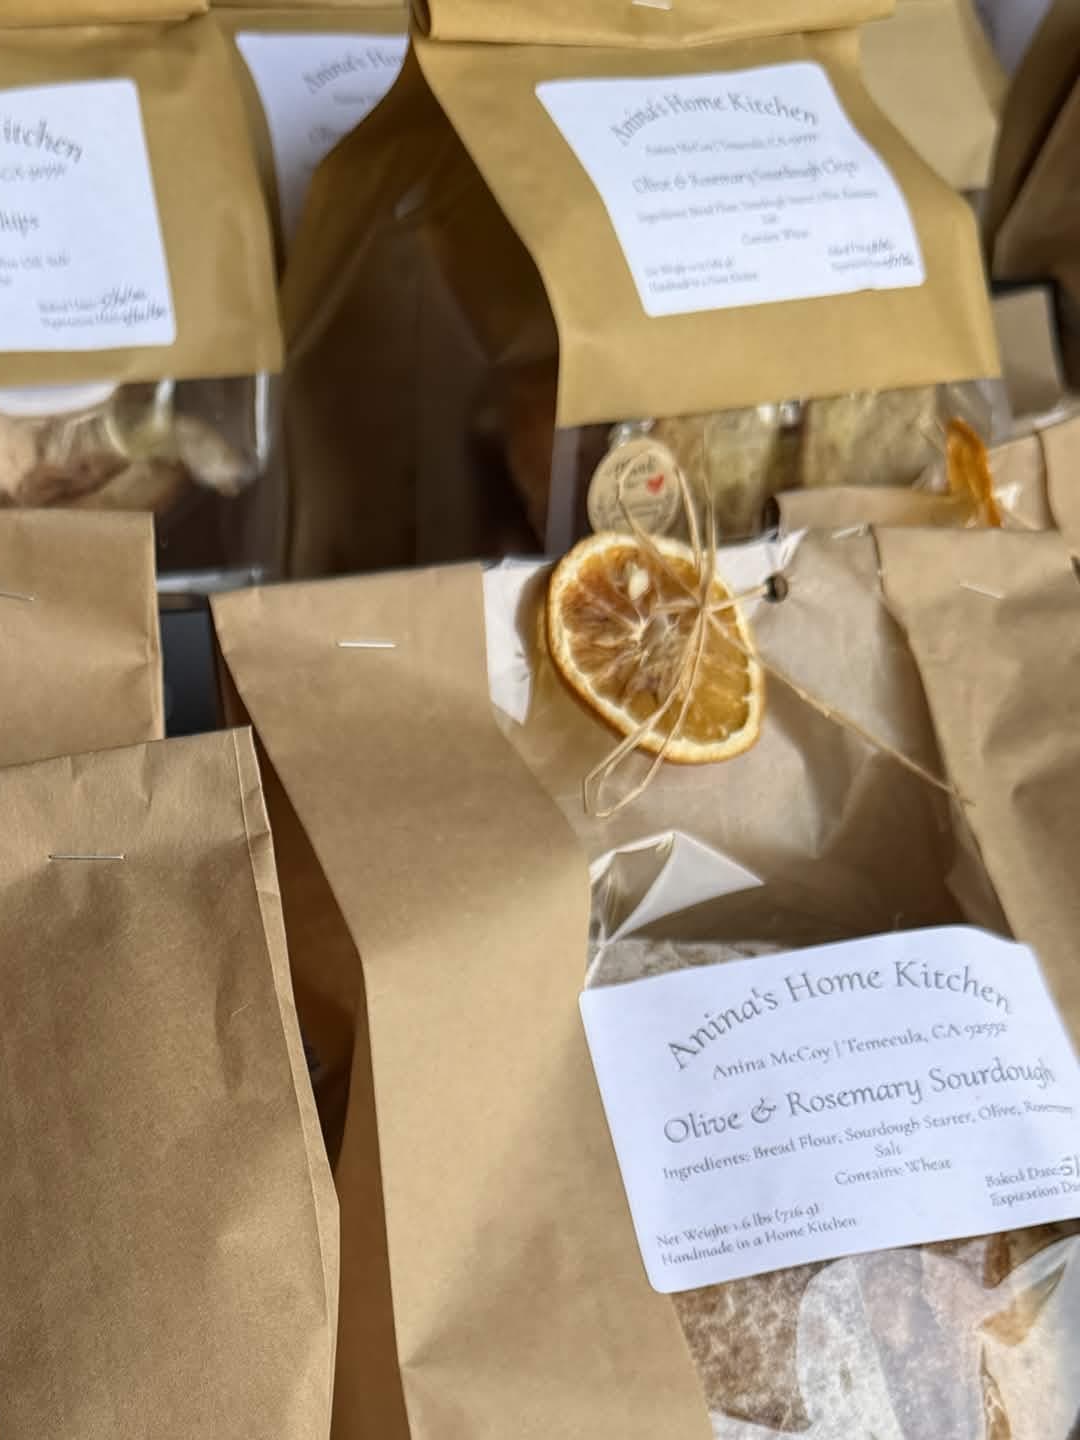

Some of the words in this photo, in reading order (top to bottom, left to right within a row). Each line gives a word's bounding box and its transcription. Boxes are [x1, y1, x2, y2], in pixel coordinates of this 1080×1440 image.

[666, 91, 727, 115] Home
[727, 90, 818, 126] Kitchen
[666, 986, 780, 1070] Anina's
[784, 967, 884, 1003] Home
[893, 960, 1012, 1014] Kitchen
[713, 1057, 767, 1081] Anina
[770, 1046, 832, 1069] McCoy
[845, 1029, 929, 1056] Temecula,
[930, 1023, 961, 1041] CA
[663, 1108, 744, 1144] Olive
[751, 1098, 778, 1124] &
[786, 1073, 923, 1119] Rosemary
[928, 1055, 1058, 1095] Sourdough
[662, 1151, 751, 1182] Ingredients:
[752, 1137, 796, 1160] Bread
[798, 1129, 843, 1150] Flour,
[844, 1116, 921, 1143] Sourdough
[978, 1103, 1023, 1121] Olive,
[873, 1142, 903, 1160] Salt
[905, 1157, 953, 1176] Wheat
[985, 1171, 1026, 1188] Baked
[989, 1185, 1058, 1208] Expiration
[656, 1233, 680, 1248] Net
[683, 1221, 730, 1243] Weight
[752, 1211, 772, 1228] lbs
[661, 1240, 735, 1266] Handmade
[736, 1237, 750, 1251] in
[751, 1237, 764, 1248] a
[765, 1226, 805, 1245] Home
[806, 1215, 858, 1235] Kitchen
